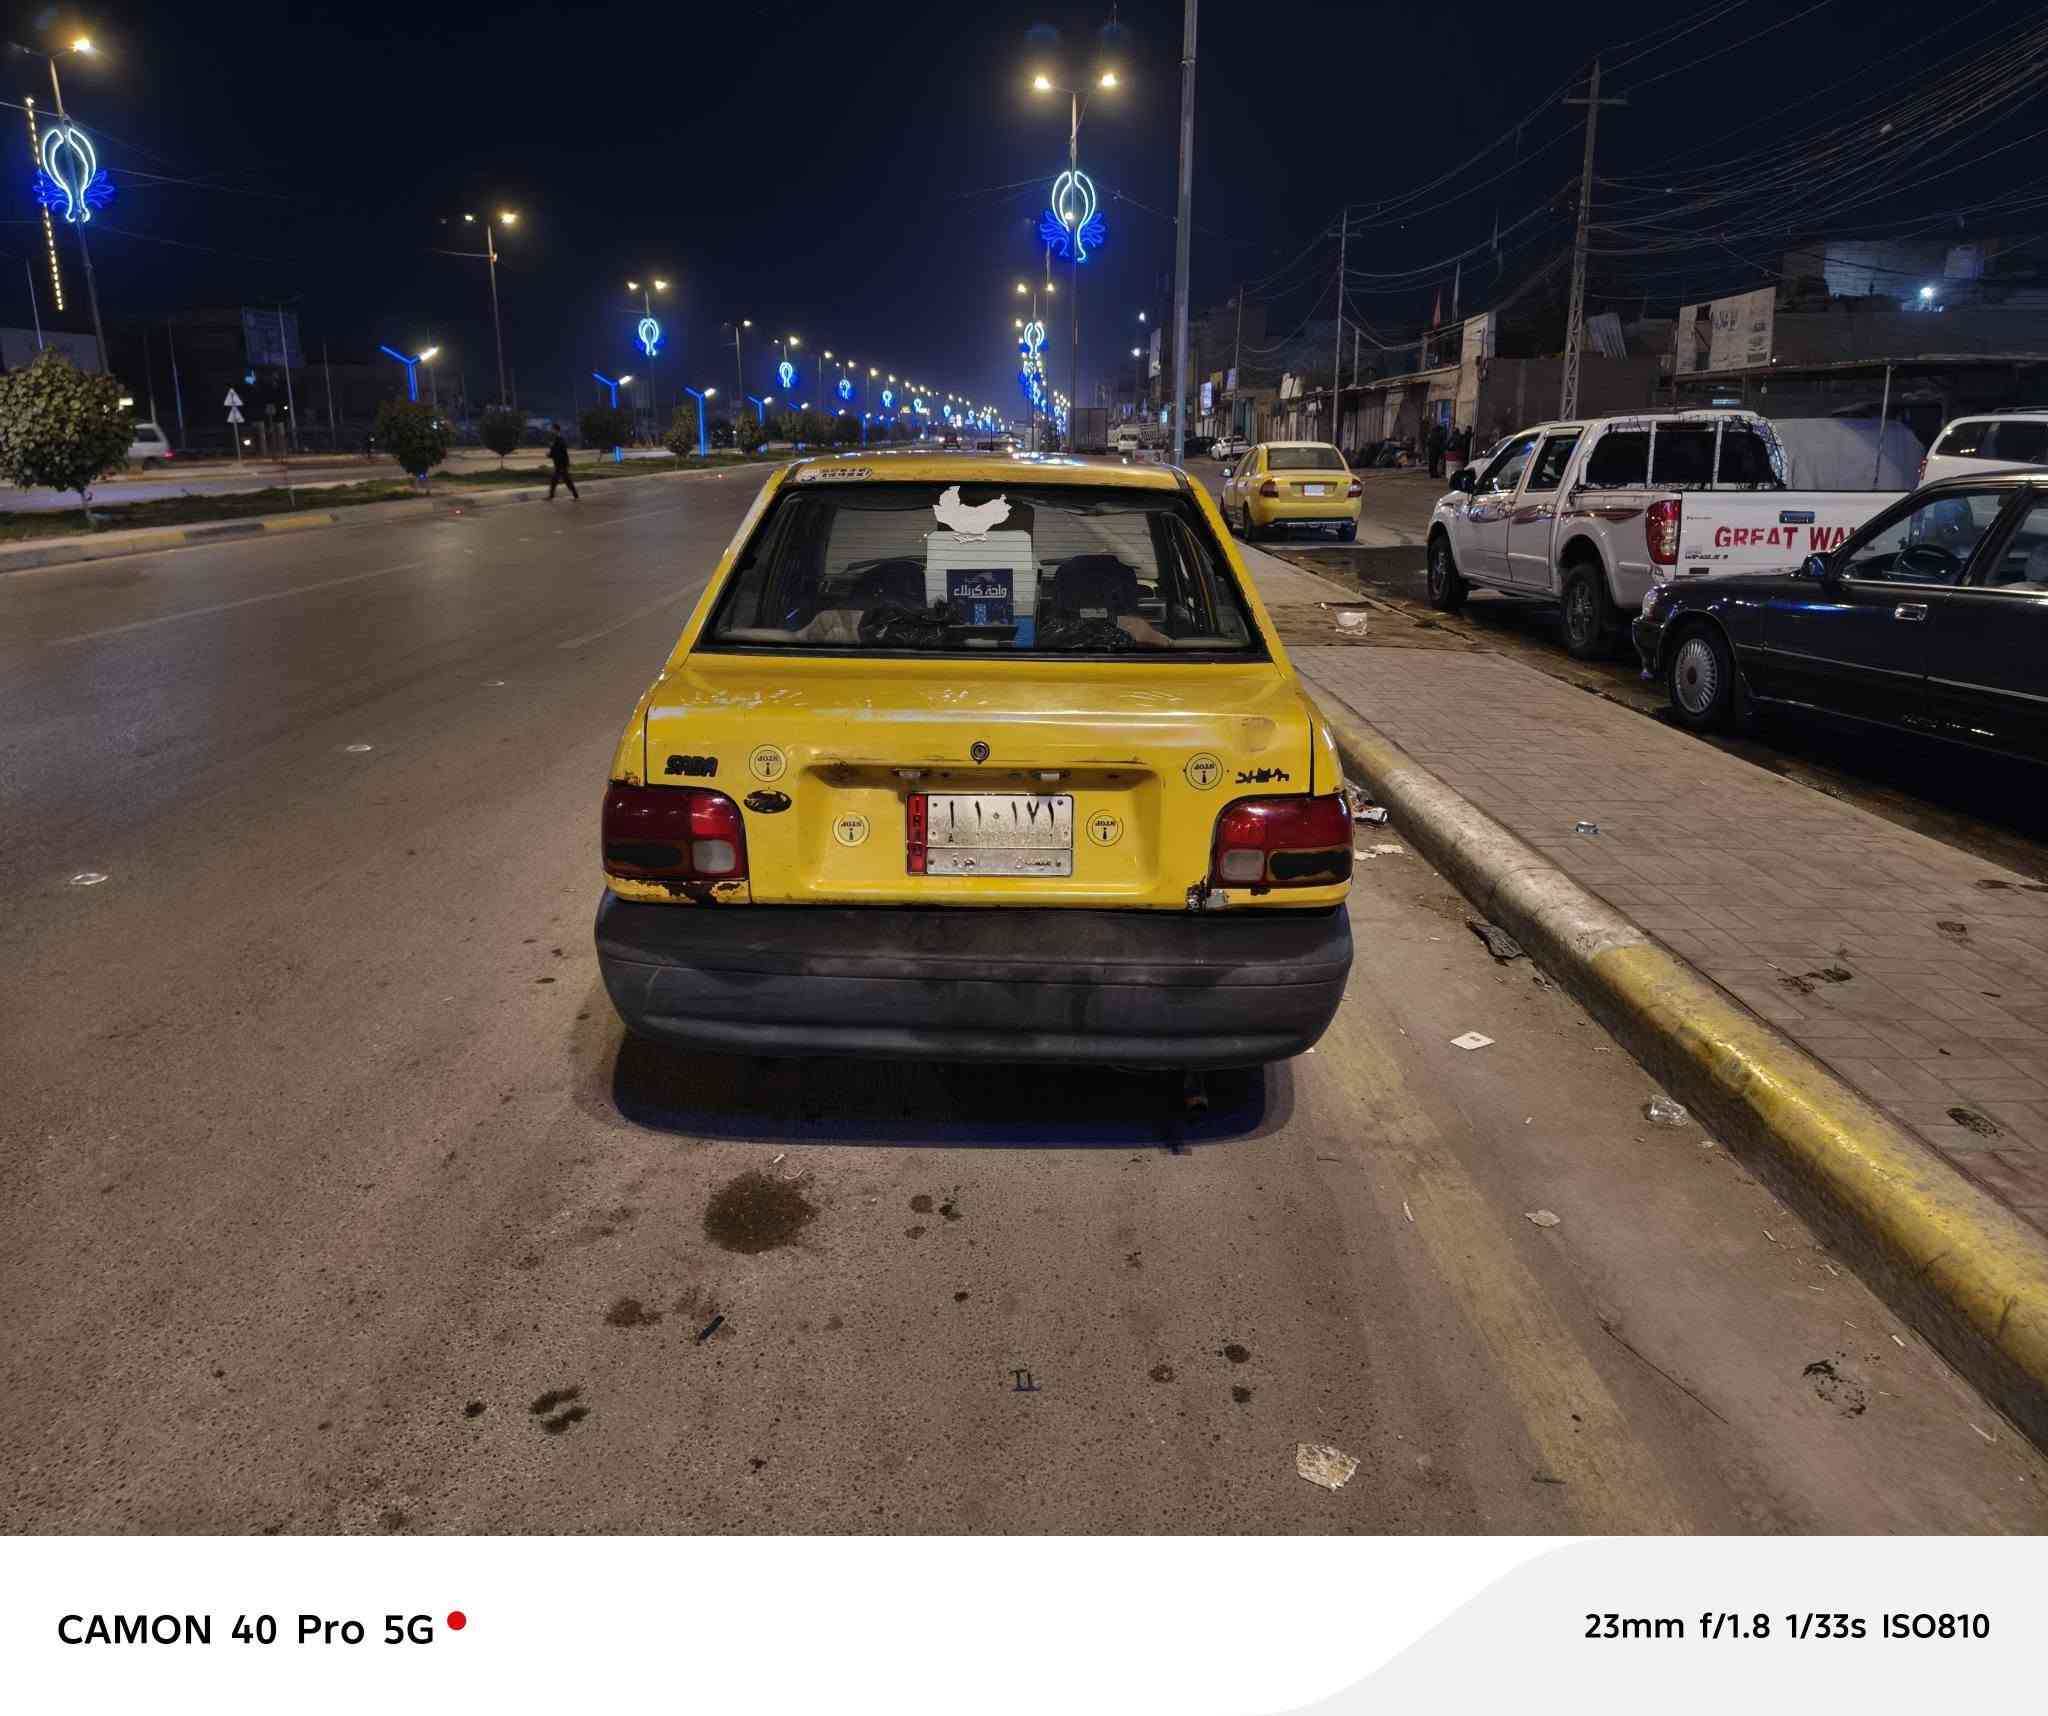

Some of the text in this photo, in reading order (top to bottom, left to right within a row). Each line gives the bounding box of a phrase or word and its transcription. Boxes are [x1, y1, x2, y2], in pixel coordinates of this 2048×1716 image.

[1714, 526, 1799, 550] GREAT
[953, 583, 1008, 598] واحة كربلاء
